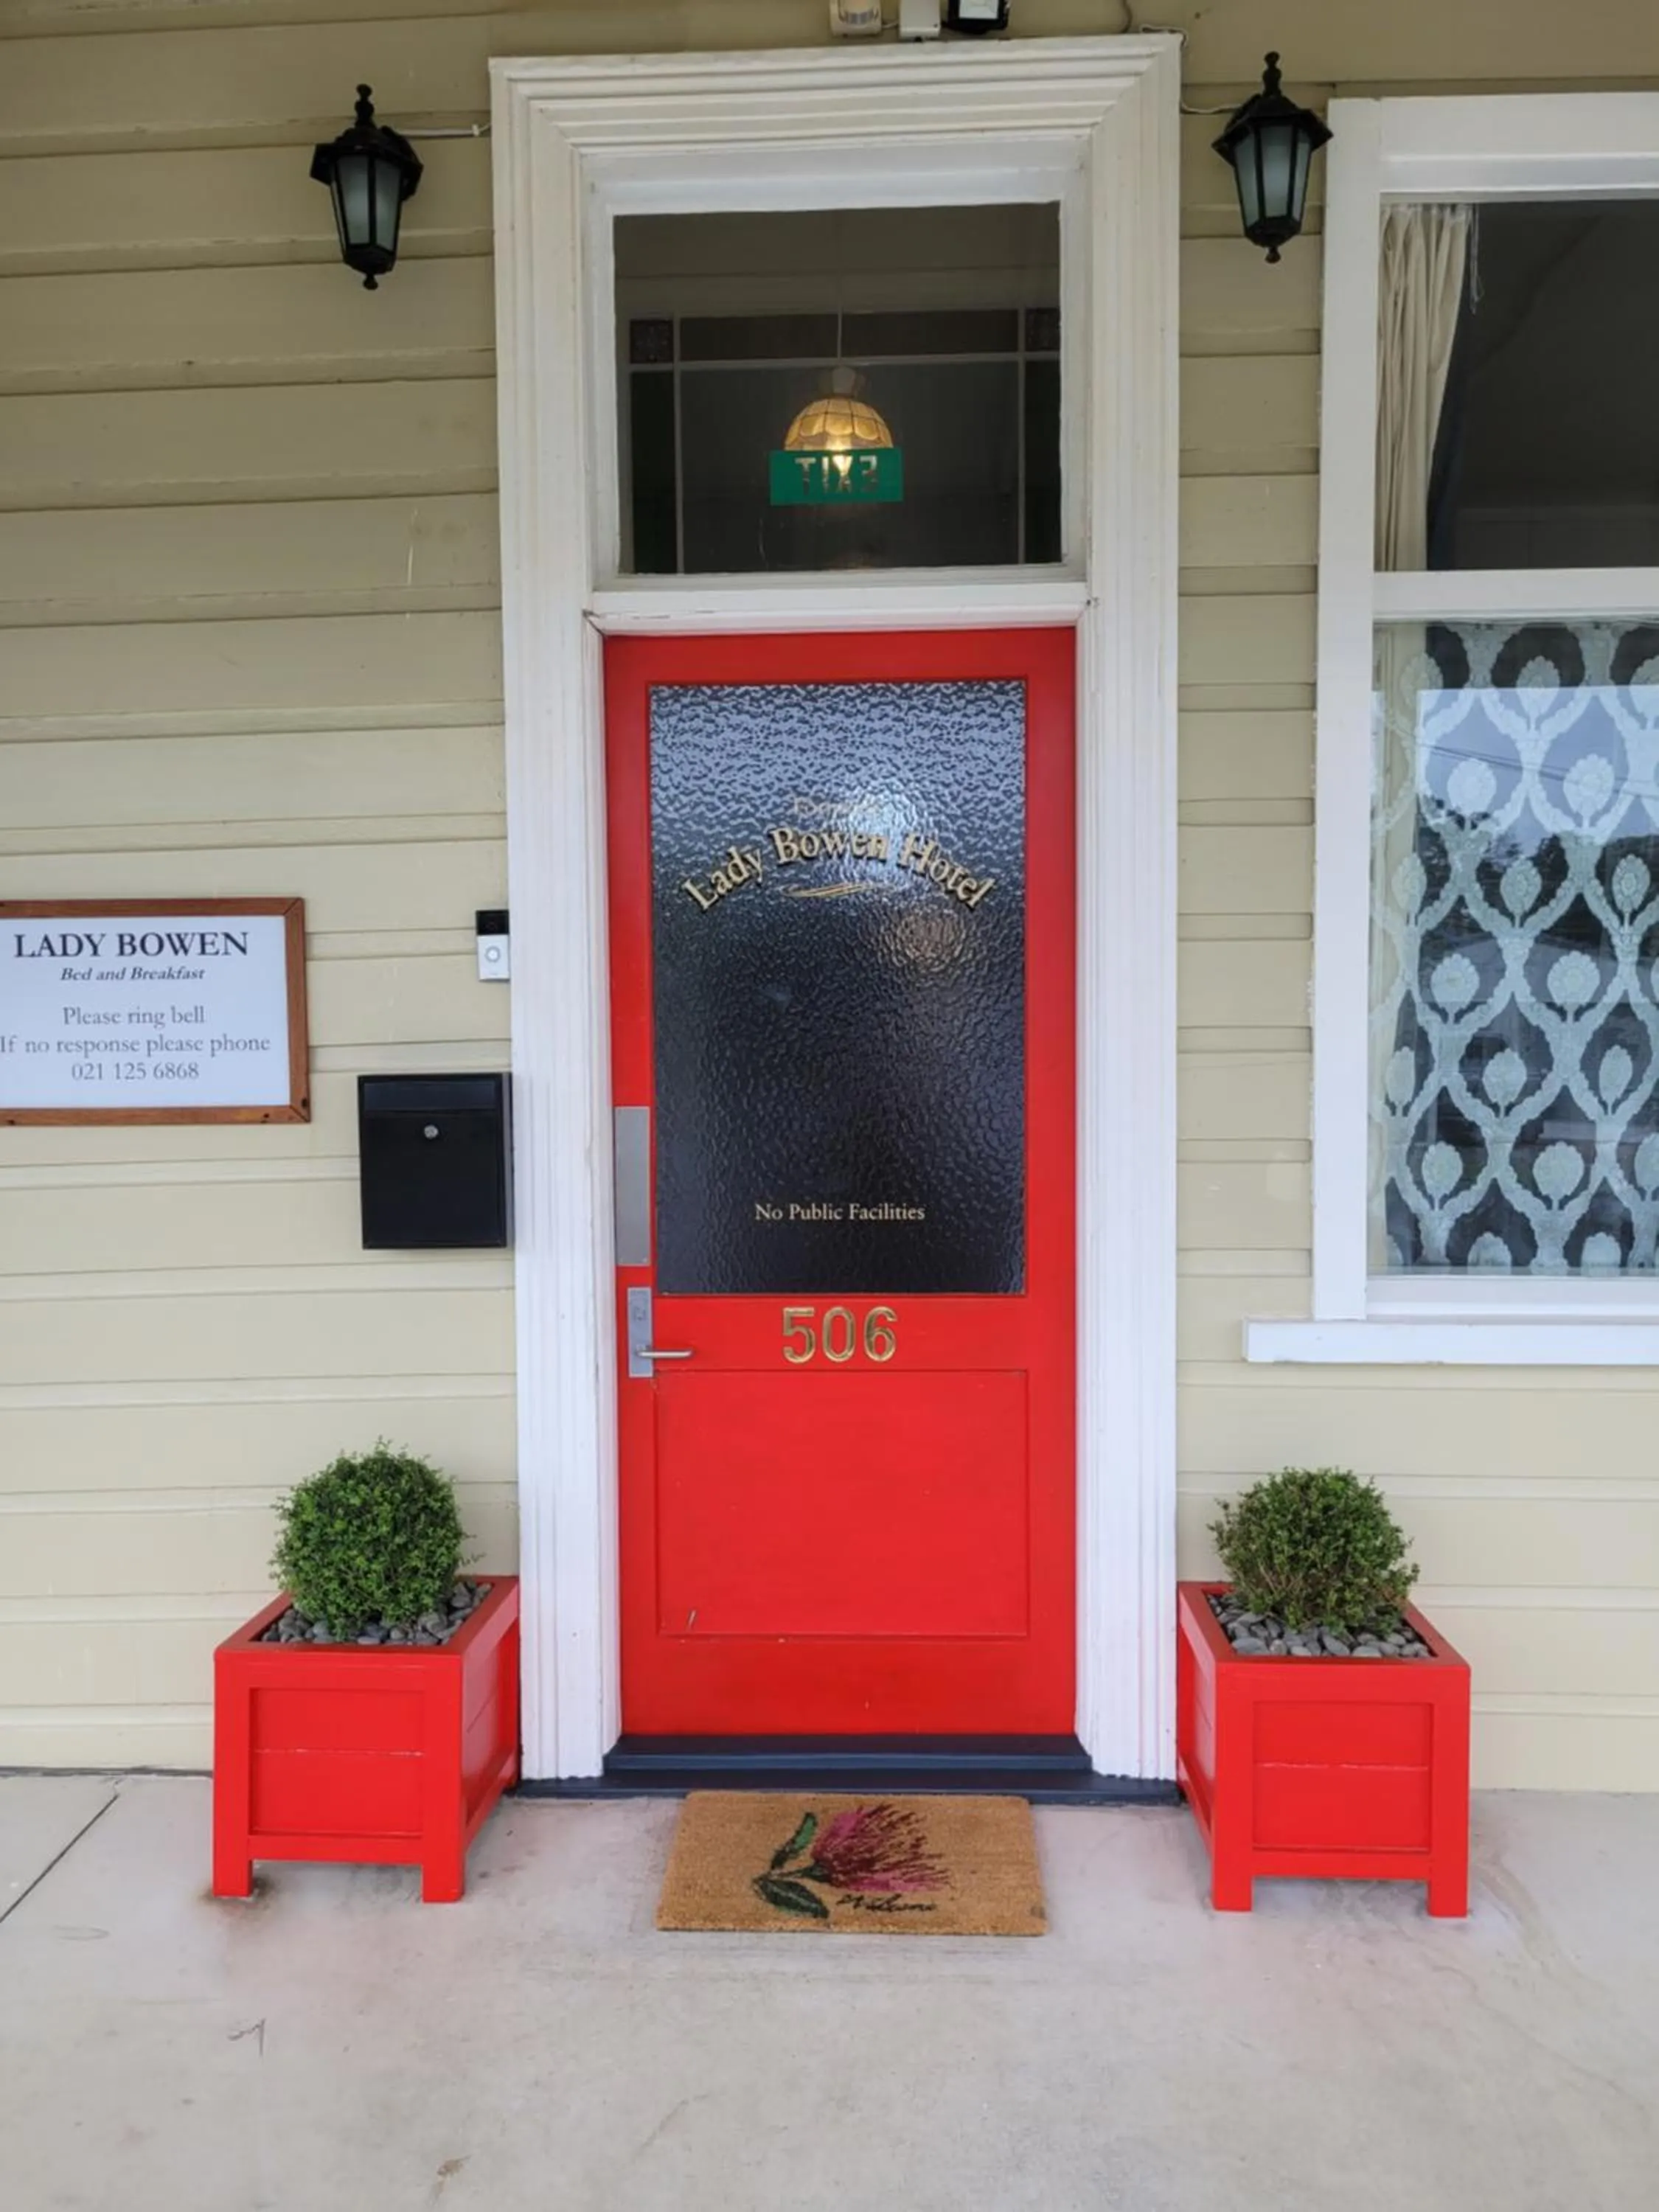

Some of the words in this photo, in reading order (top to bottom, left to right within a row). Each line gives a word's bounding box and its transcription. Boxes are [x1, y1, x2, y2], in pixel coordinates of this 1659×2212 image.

[684, 845, 765, 910] Lady
[771, 827, 888, 865] Bowen
[898, 830, 995, 910] Hotel
[13, 933, 107, 958] LADY
[116, 931, 249, 957] BOWEN
[60, 967, 92, 981] Bed
[96, 967, 126, 981] and
[129, 965, 206, 981] Breakfast
[63, 1006, 122, 1026] Please
[128, 1006, 165, 1028] ring
[171, 1005, 206, 1024] bell
[0, 1034, 18, 1053] If
[25, 1041, 50, 1053] no
[56, 1038, 141, 1059] response
[147, 1034, 204, 1057] please
[209, 1033, 271, 1057] phone
[71, 1063, 104, 1081] 021
[114, 1062, 147, 1080] 125
[153, 1062, 200, 1079] 6868
[754, 1203, 783, 1220] No
[789, 1203, 844, 1220] Public
[849, 1203, 926, 1220] Facilities
[782, 1306, 898, 1364] 506
